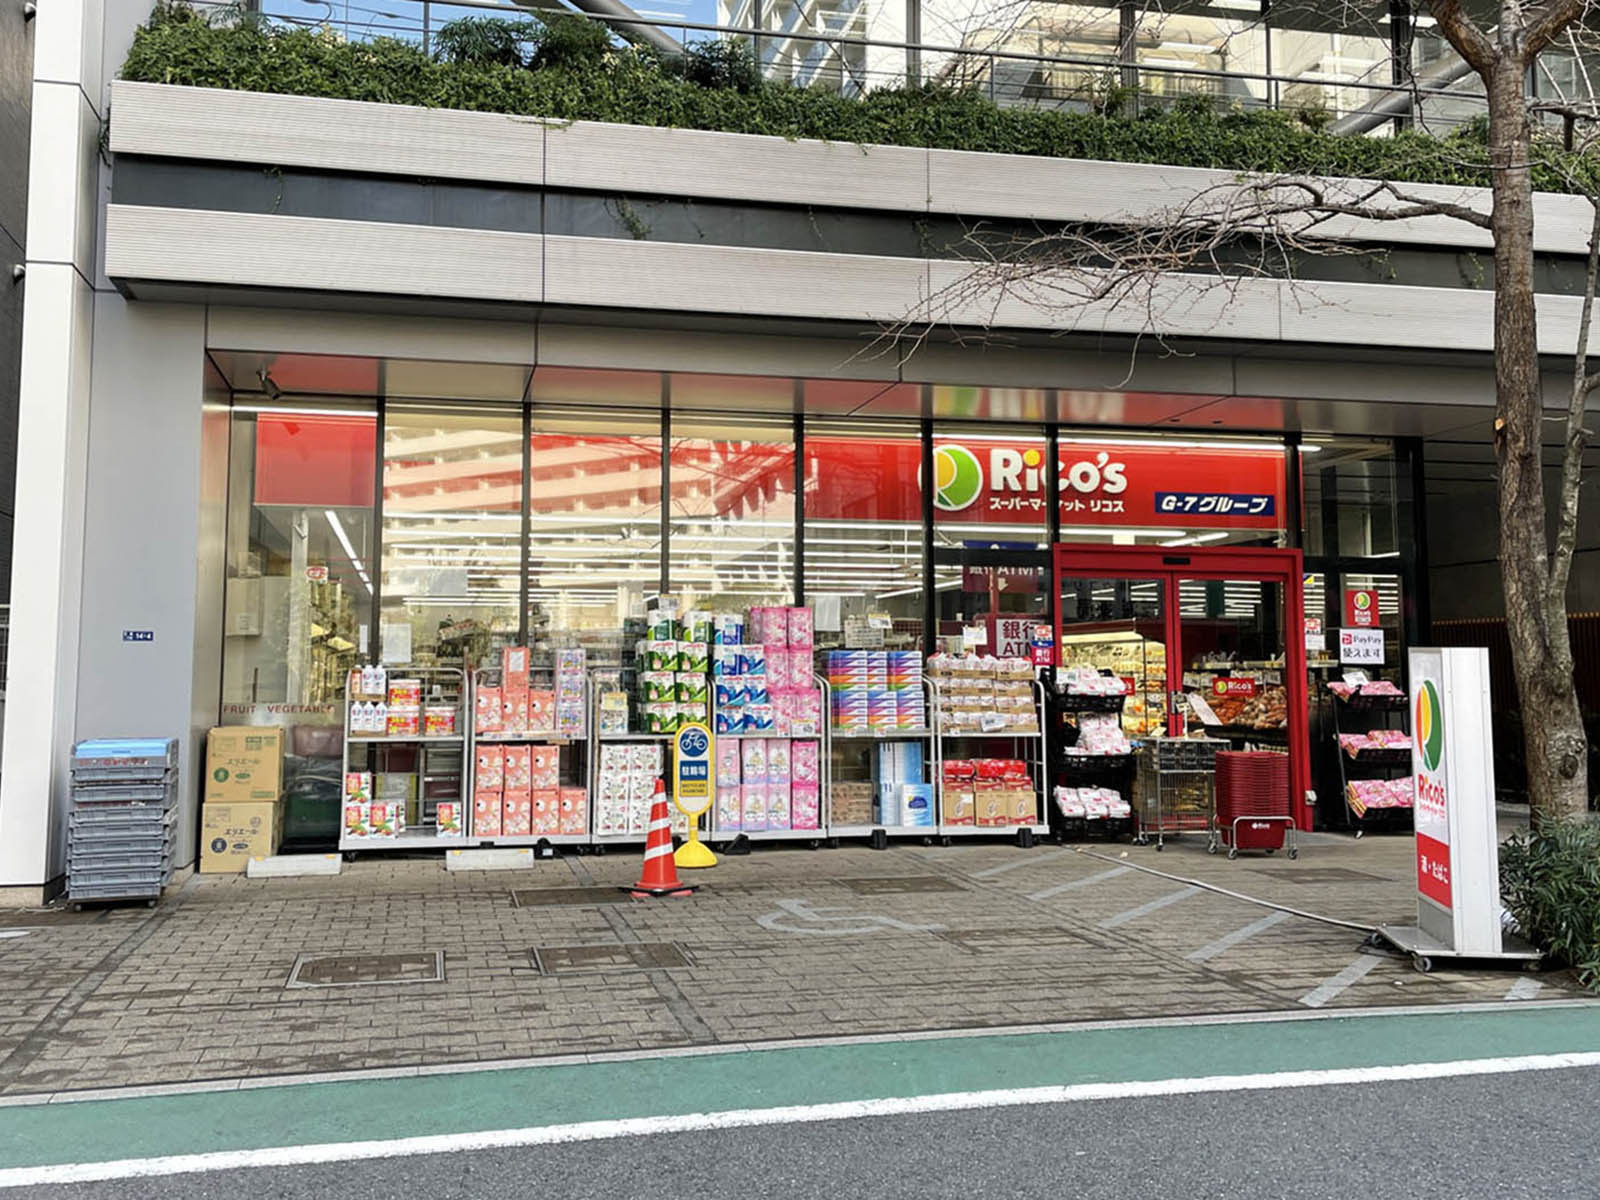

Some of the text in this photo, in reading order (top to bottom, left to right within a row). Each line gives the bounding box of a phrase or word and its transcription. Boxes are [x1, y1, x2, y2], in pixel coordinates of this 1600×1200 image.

[989, 448, 1128, 494] Rico's
[1090, 499, 1125, 512] リコス
[1353, 635, 1381, 646] PayPay
[222, 704, 257, 714] FRUIT
[1417, 773, 1446, 806] Rico's
